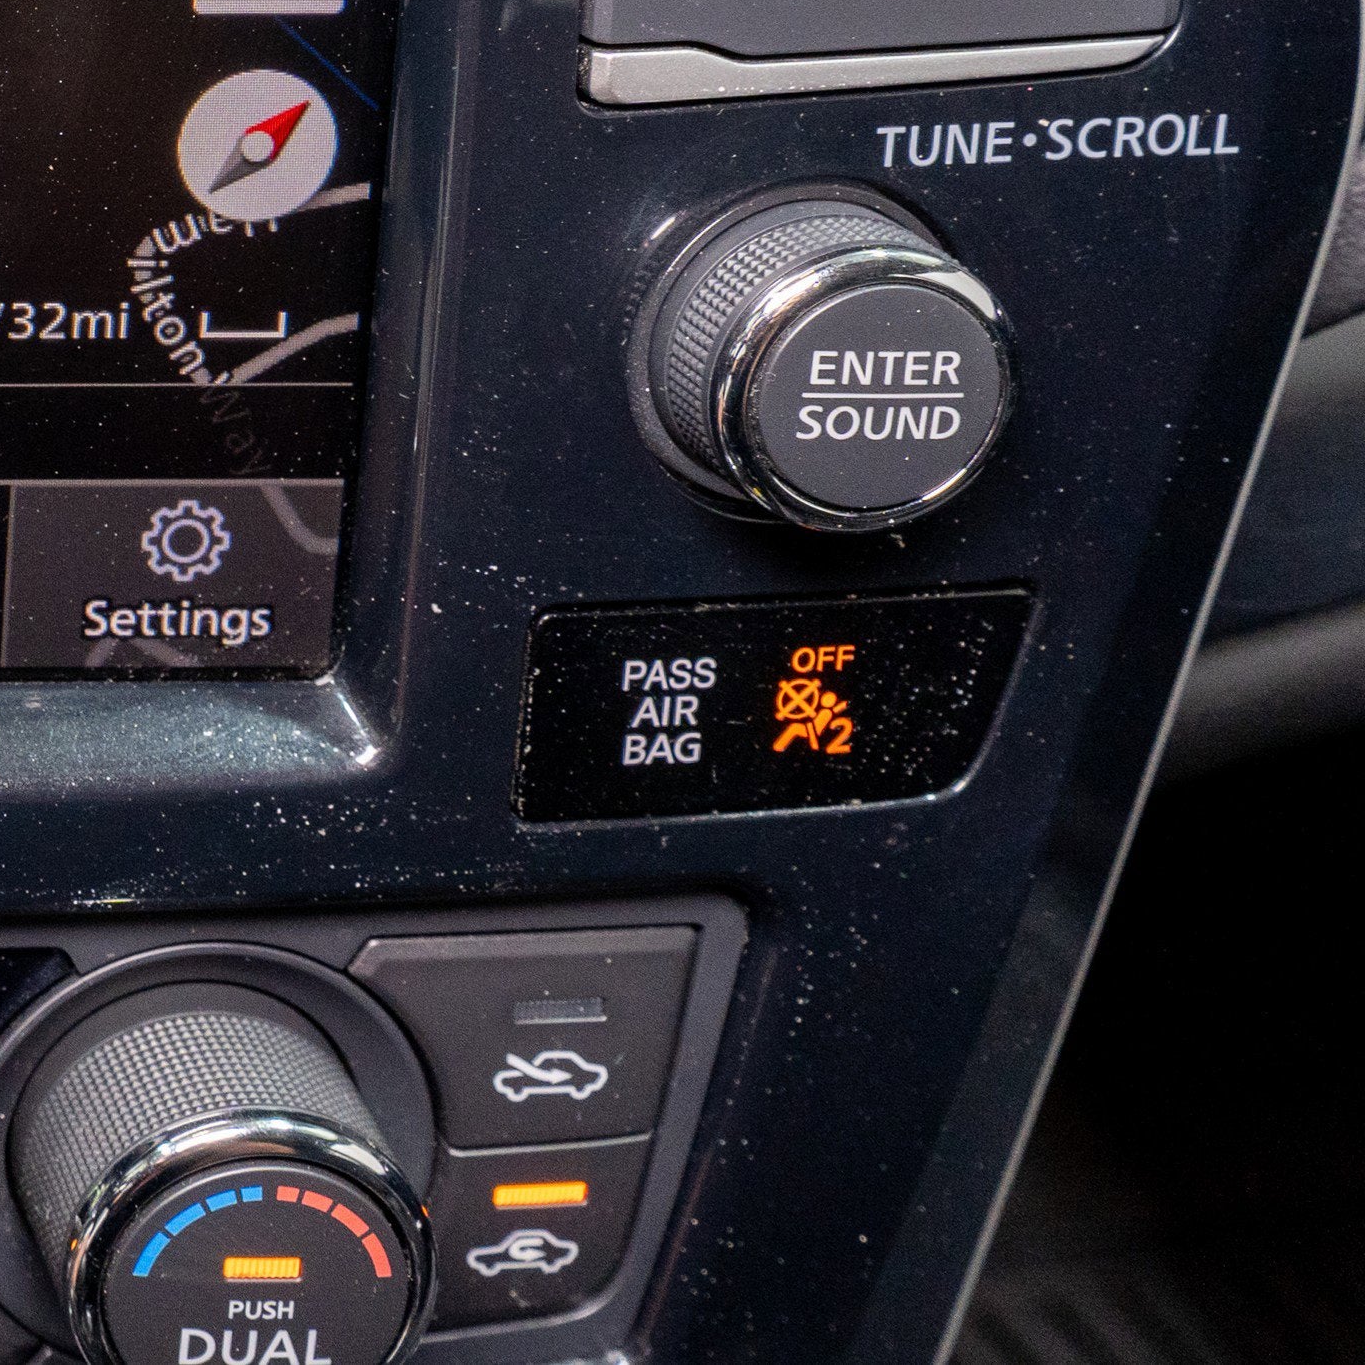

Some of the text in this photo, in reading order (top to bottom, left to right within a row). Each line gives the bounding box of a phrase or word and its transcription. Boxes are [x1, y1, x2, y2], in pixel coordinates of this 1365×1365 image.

[809, 350, 961, 387] ENTER
[796, 405, 961, 441] SOUND
[82, 599, 271, 645] Settings
[621, 658, 717, 692] PASS
[791, 645, 856, 674] OFF
[631, 696, 699, 728] AIR
[622, 734, 703, 767] BAG
[228, 1299, 295, 1320] PUSH
[177, 1327, 332, 1365] DUAL
